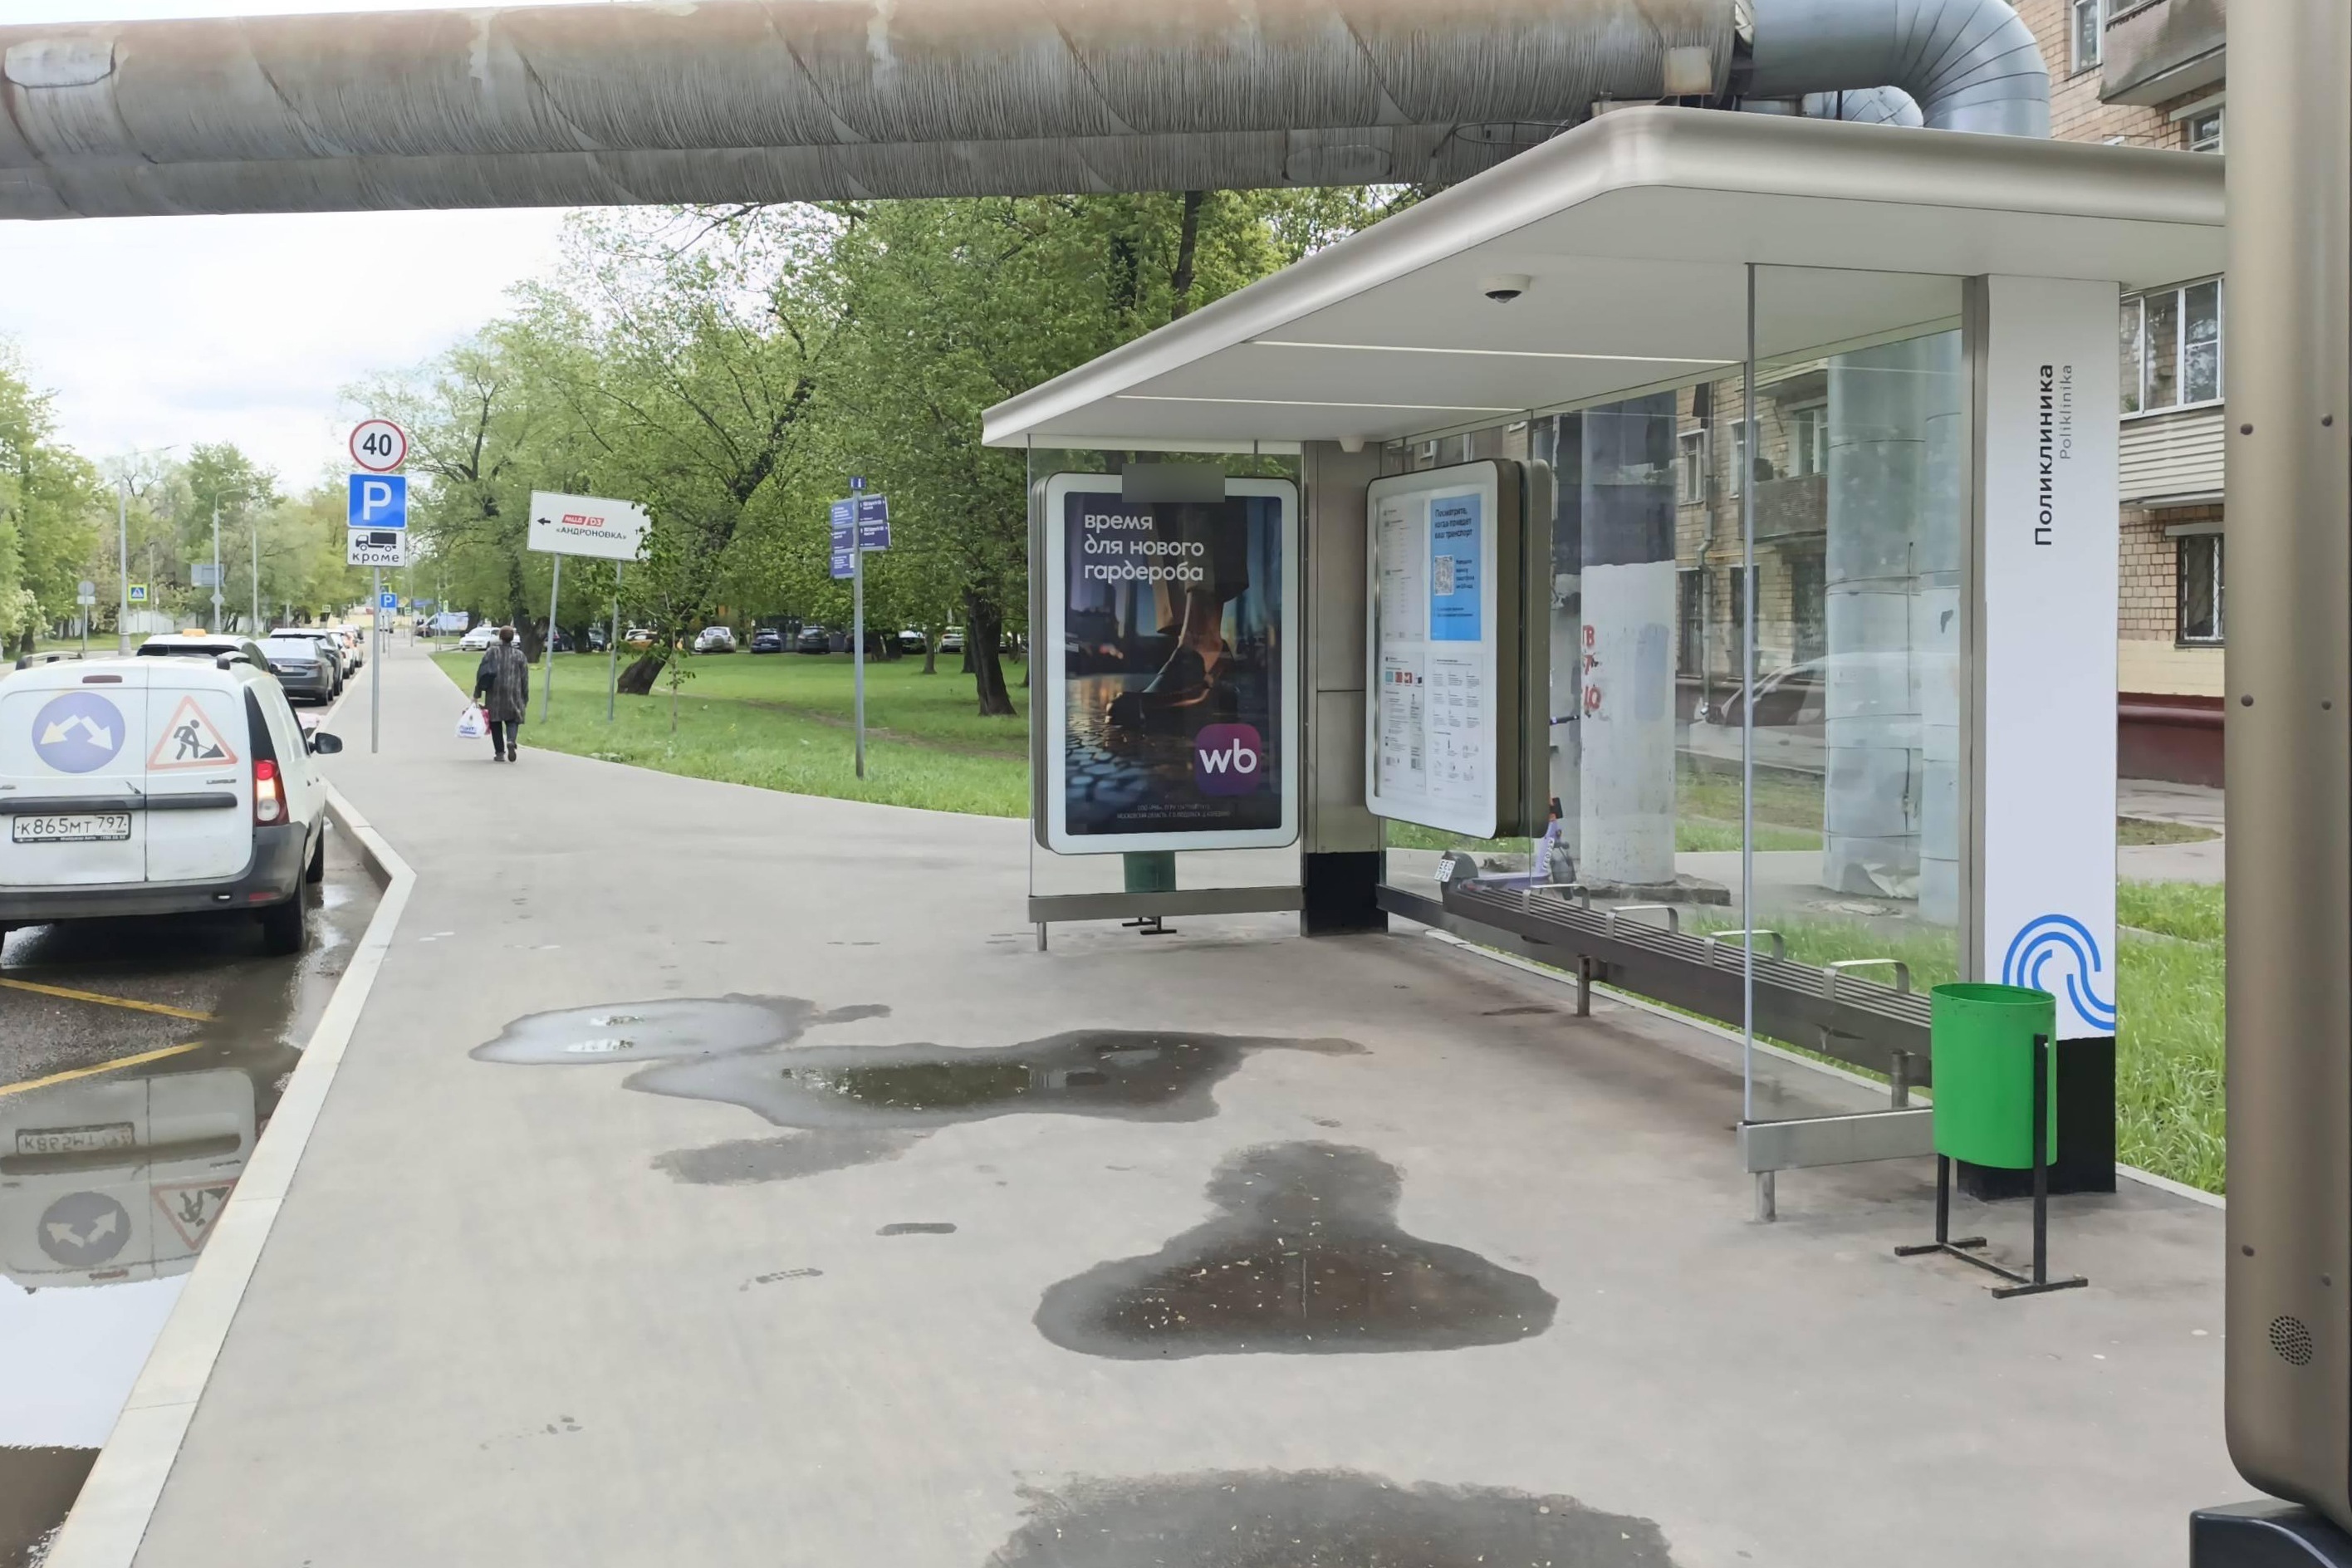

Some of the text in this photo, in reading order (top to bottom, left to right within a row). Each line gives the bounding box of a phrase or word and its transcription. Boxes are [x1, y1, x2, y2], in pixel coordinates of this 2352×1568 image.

[2059, 365, 2072, 459] Poliklinika
[363, 433, 392, 457] 40
[2034, 364, 2053, 546] Поликлиника
[363, 481, 392, 521] P
[556, 527, 627, 539] «АНДРОНОВКА»
[1085, 514, 1153, 533] время
[1084, 534, 1204, 556] для нового
[352, 552, 399, 564] кроме
[1085, 559, 1203, 585] гардероба
[384, 595, 393, 606] P
[1199, 738, 1257, 773] wb
[97, 816, 125, 829] 797
